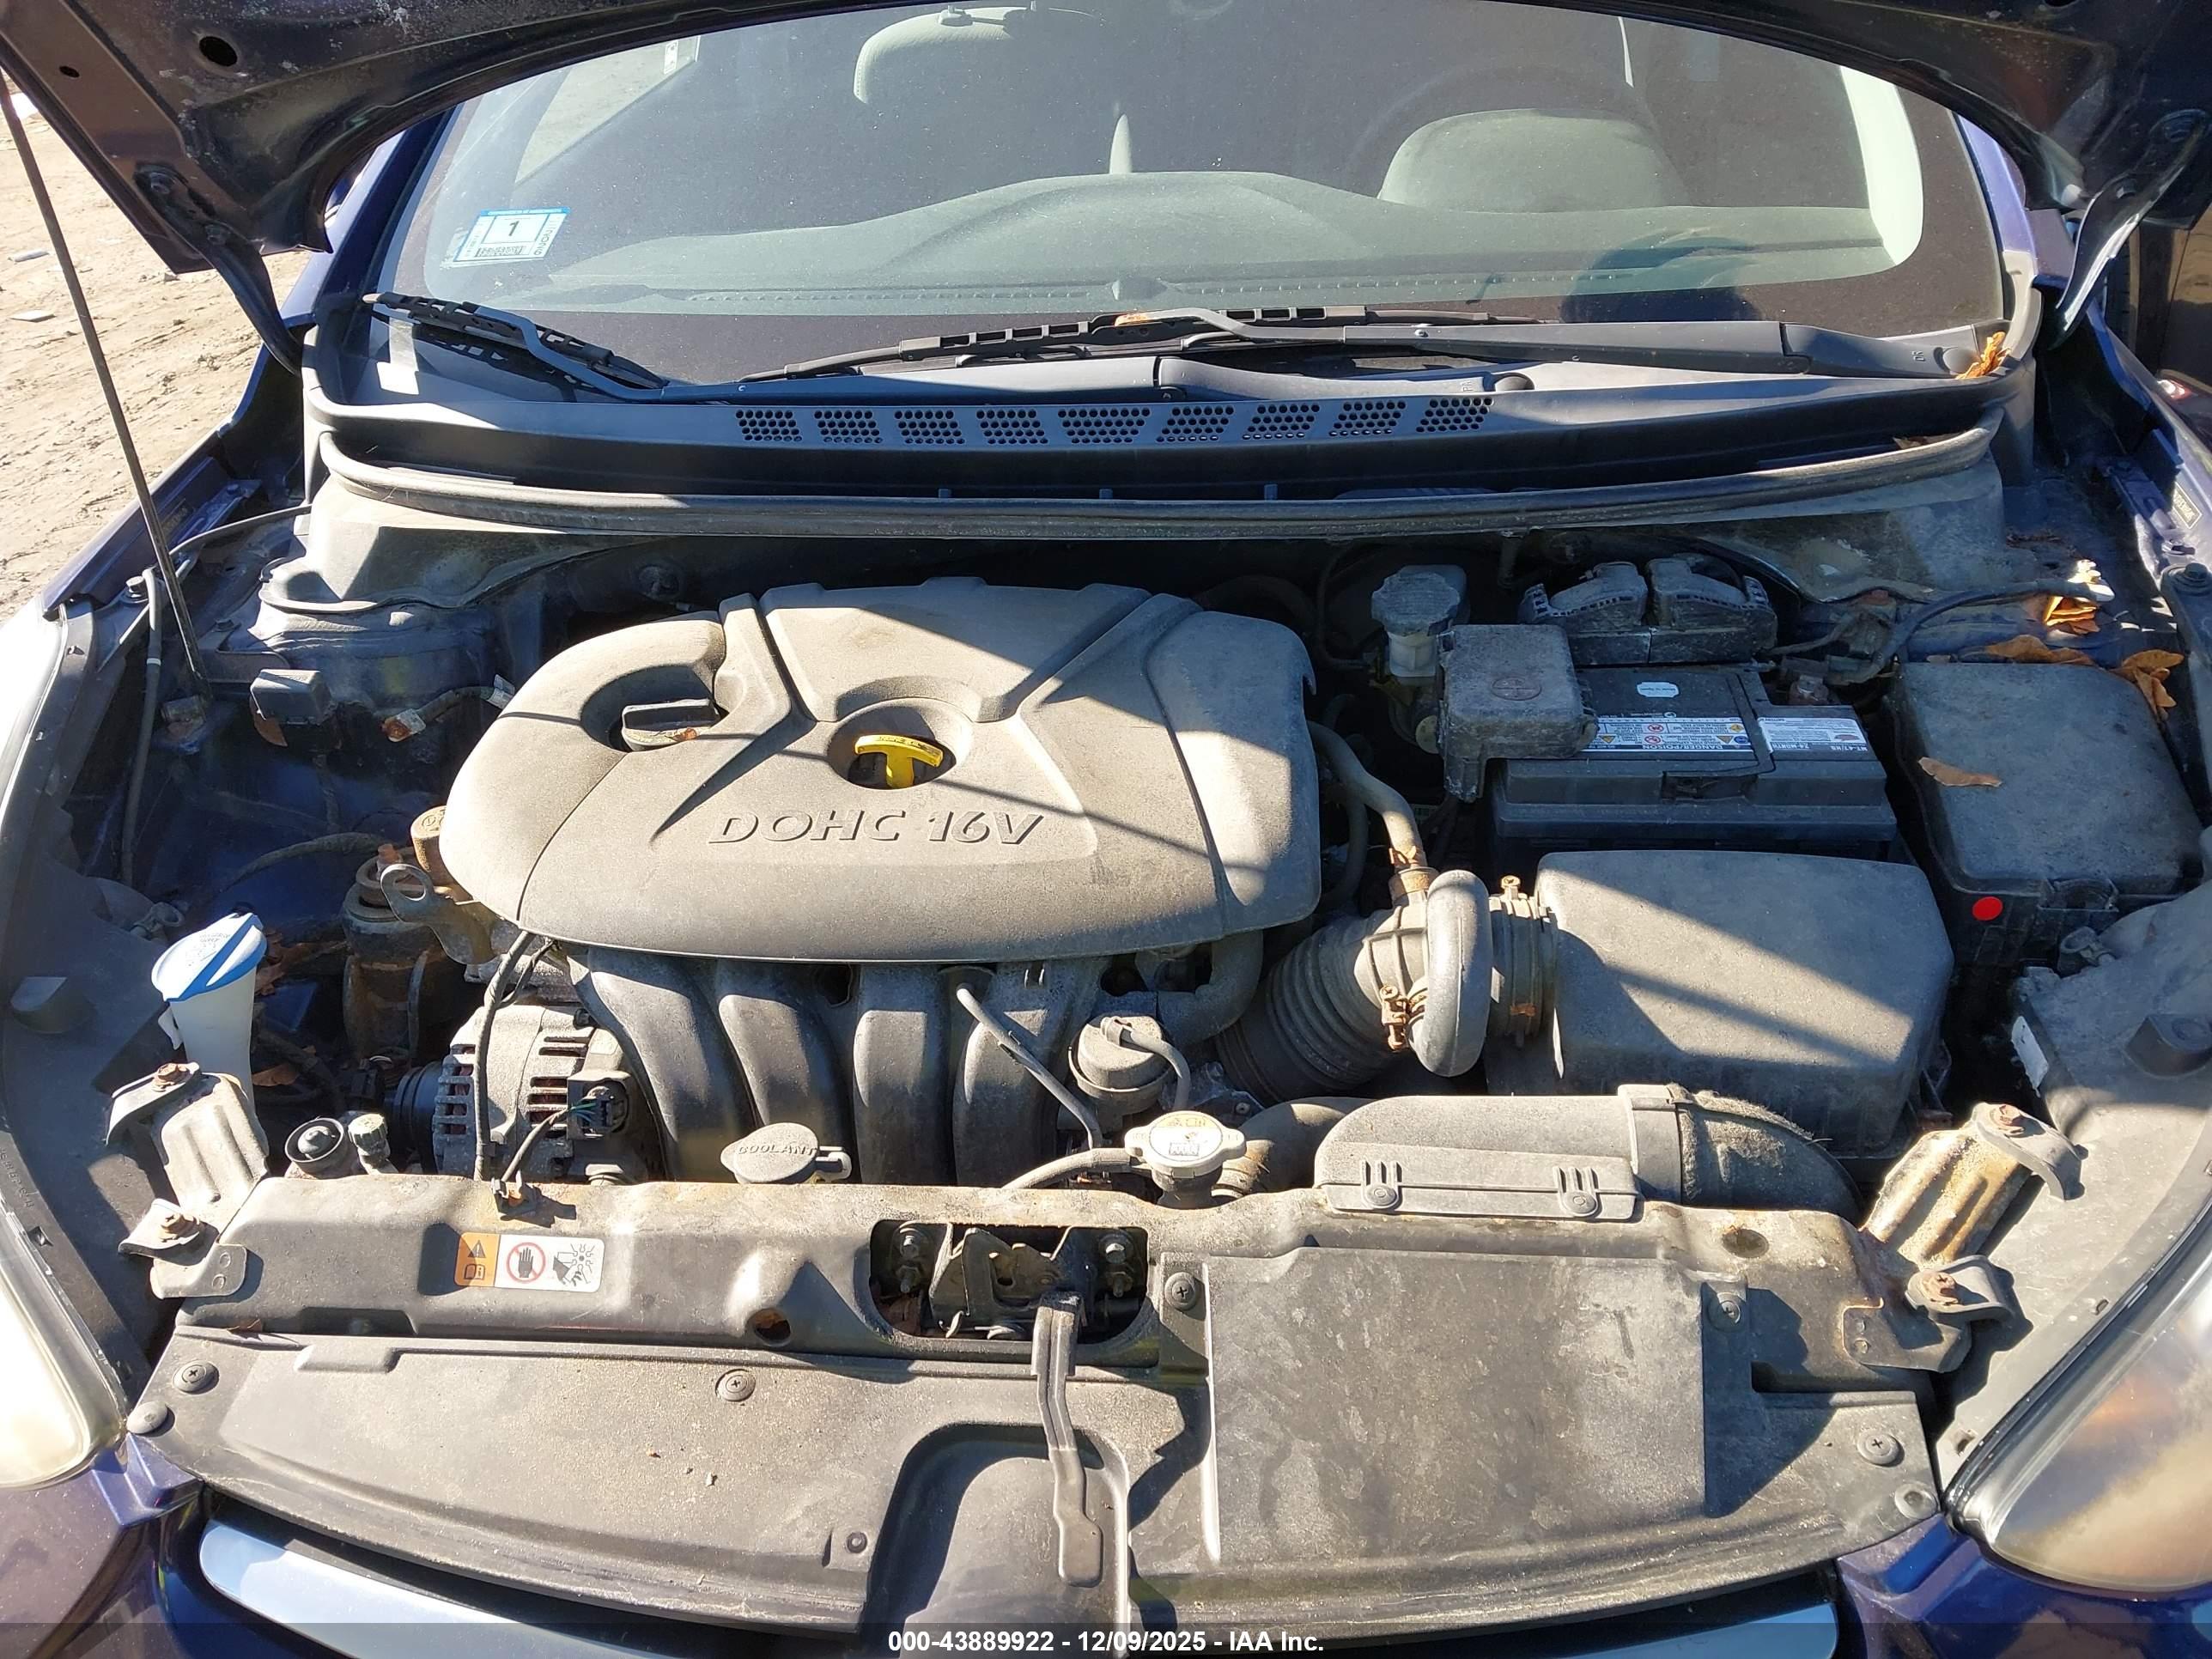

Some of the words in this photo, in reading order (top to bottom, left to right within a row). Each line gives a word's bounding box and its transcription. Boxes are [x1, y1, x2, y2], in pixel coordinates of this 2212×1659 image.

[508, 220, 520, 237] 1
[708, 810, 907, 845] DOHC
[928, 811, 1045, 845] 16V
[738, 1144, 818, 1156] COOLANT
